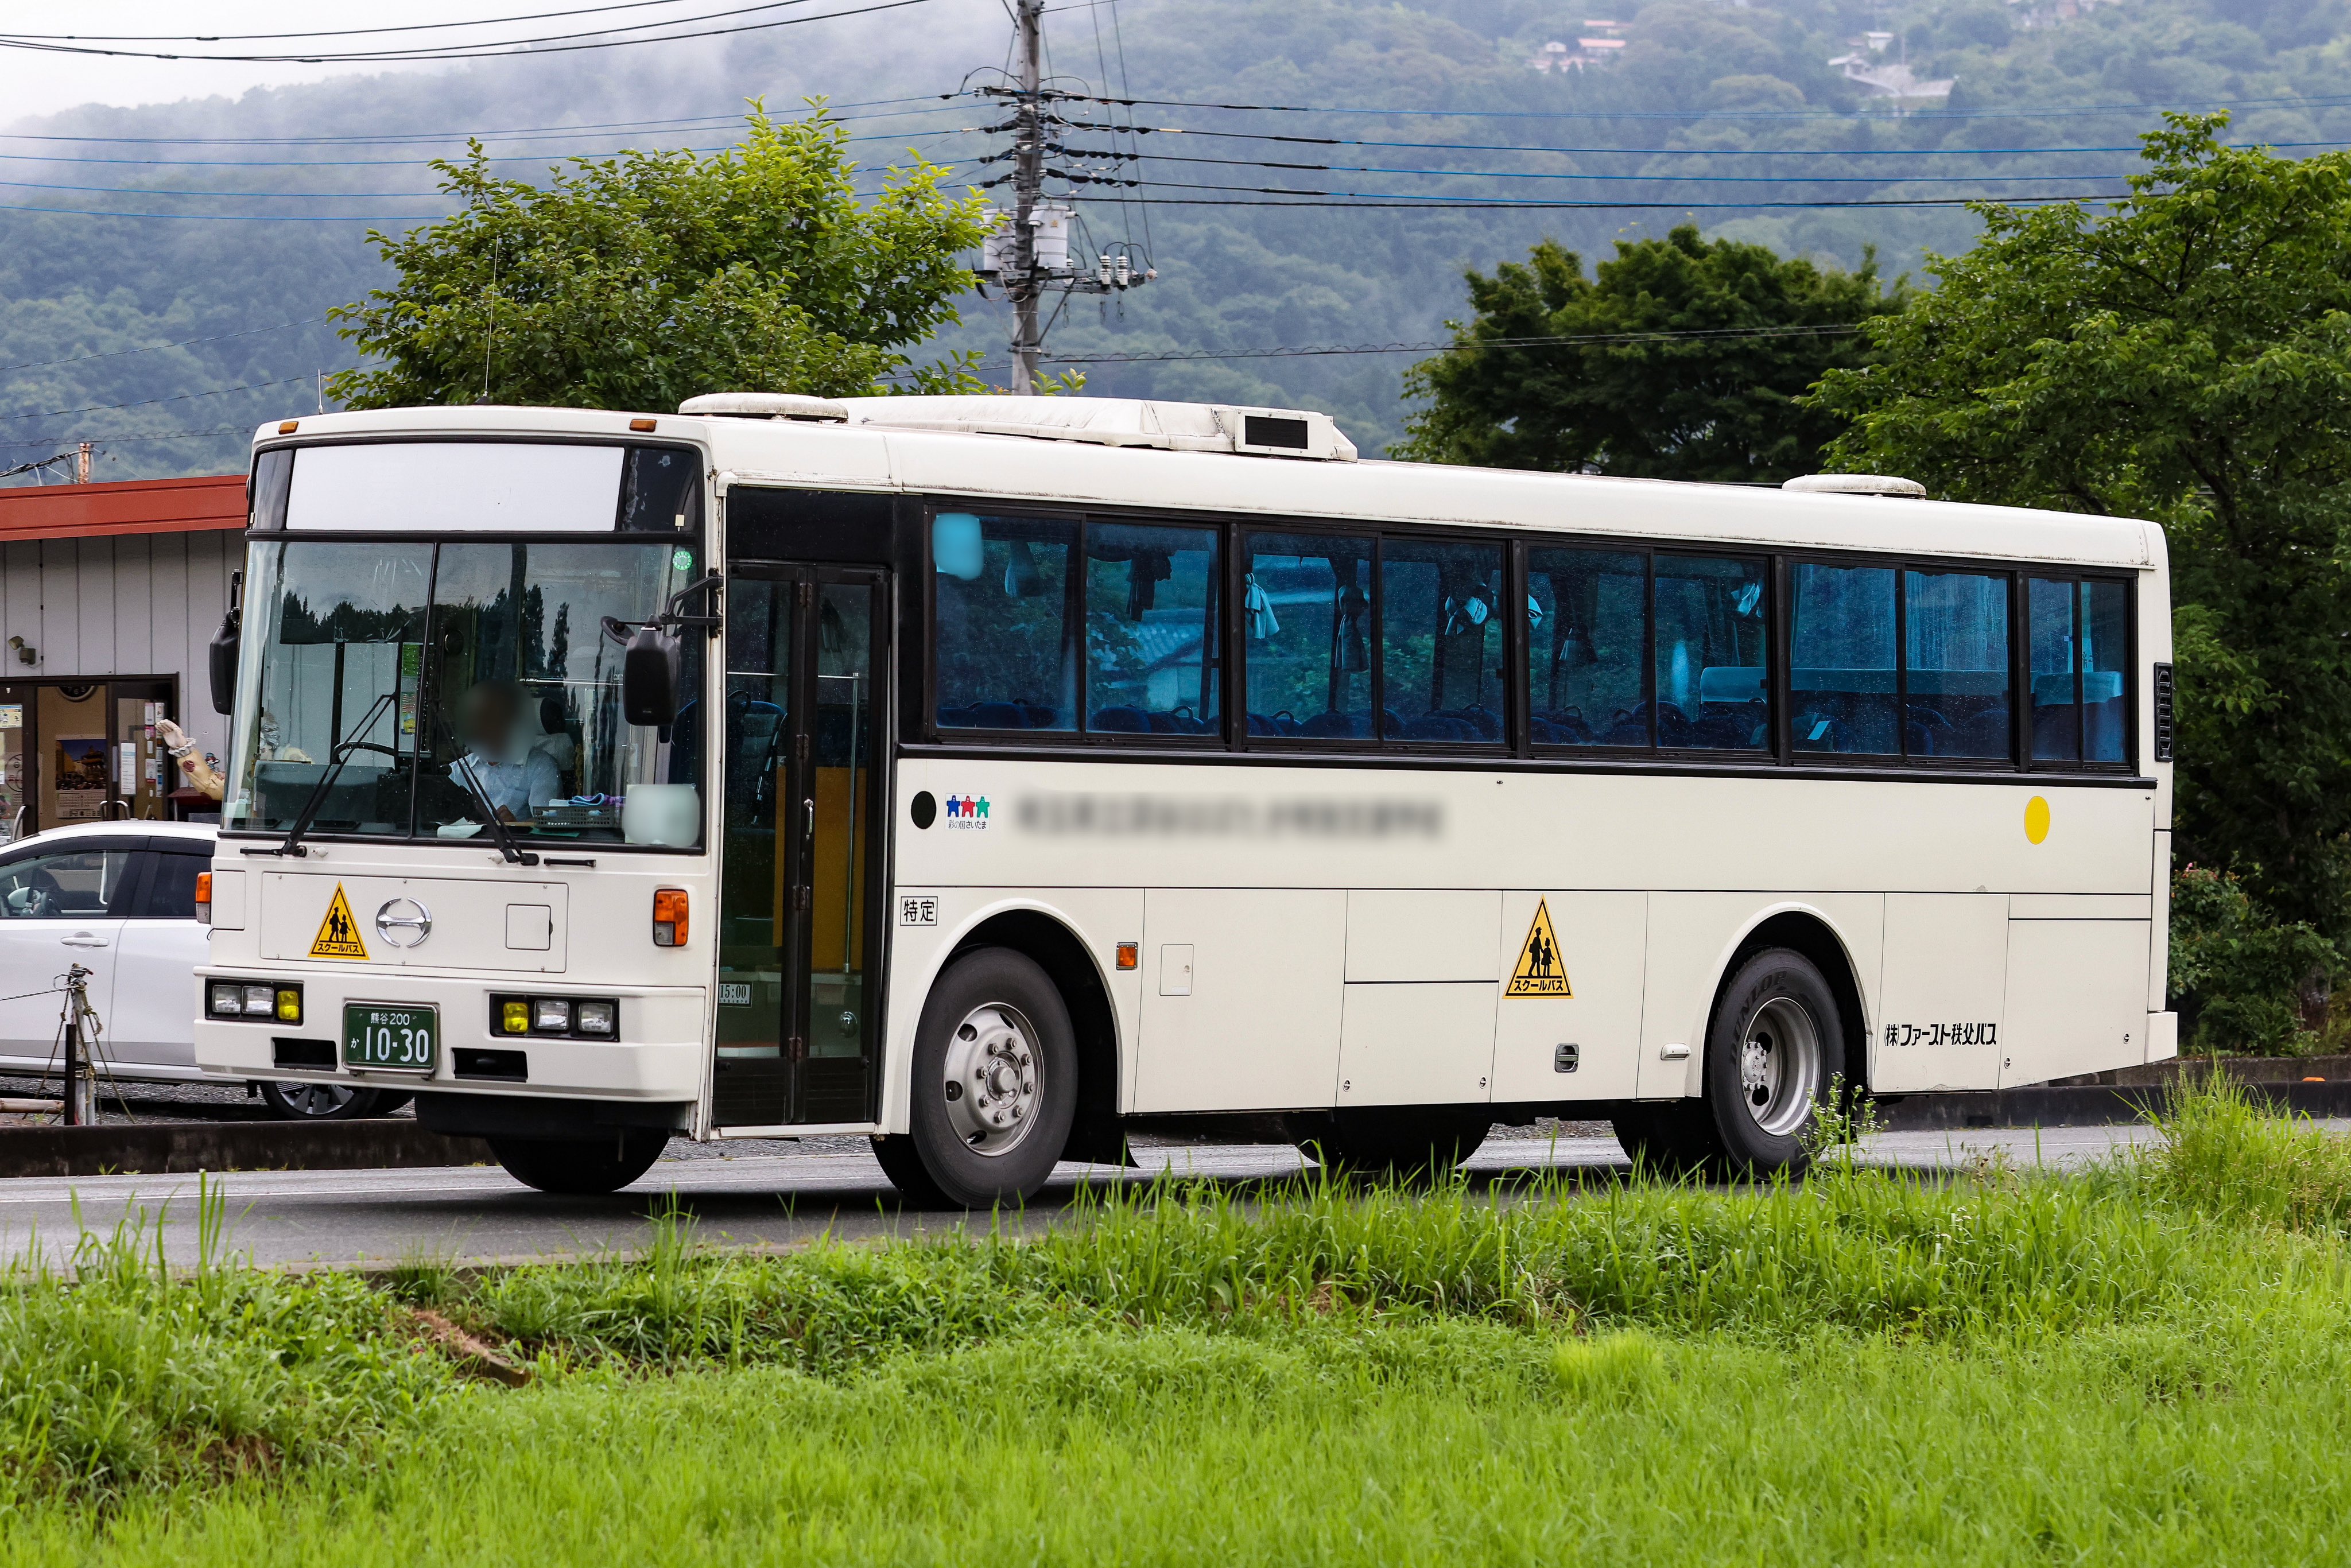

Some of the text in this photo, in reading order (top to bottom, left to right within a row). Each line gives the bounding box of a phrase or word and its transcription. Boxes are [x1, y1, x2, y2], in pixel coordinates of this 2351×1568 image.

[948, 820, 987, 829] 彩の国さいたま
[903, 899, 934, 922] 特定
[317, 943, 359, 953] スクールバス
[720, 984, 747, 999] 15:00
[1514, 979, 1564, 992] スクールバス
[1730, 970, 1787, 1066] DUNLOP
[350, 1026, 429, 1063] か 10-30
